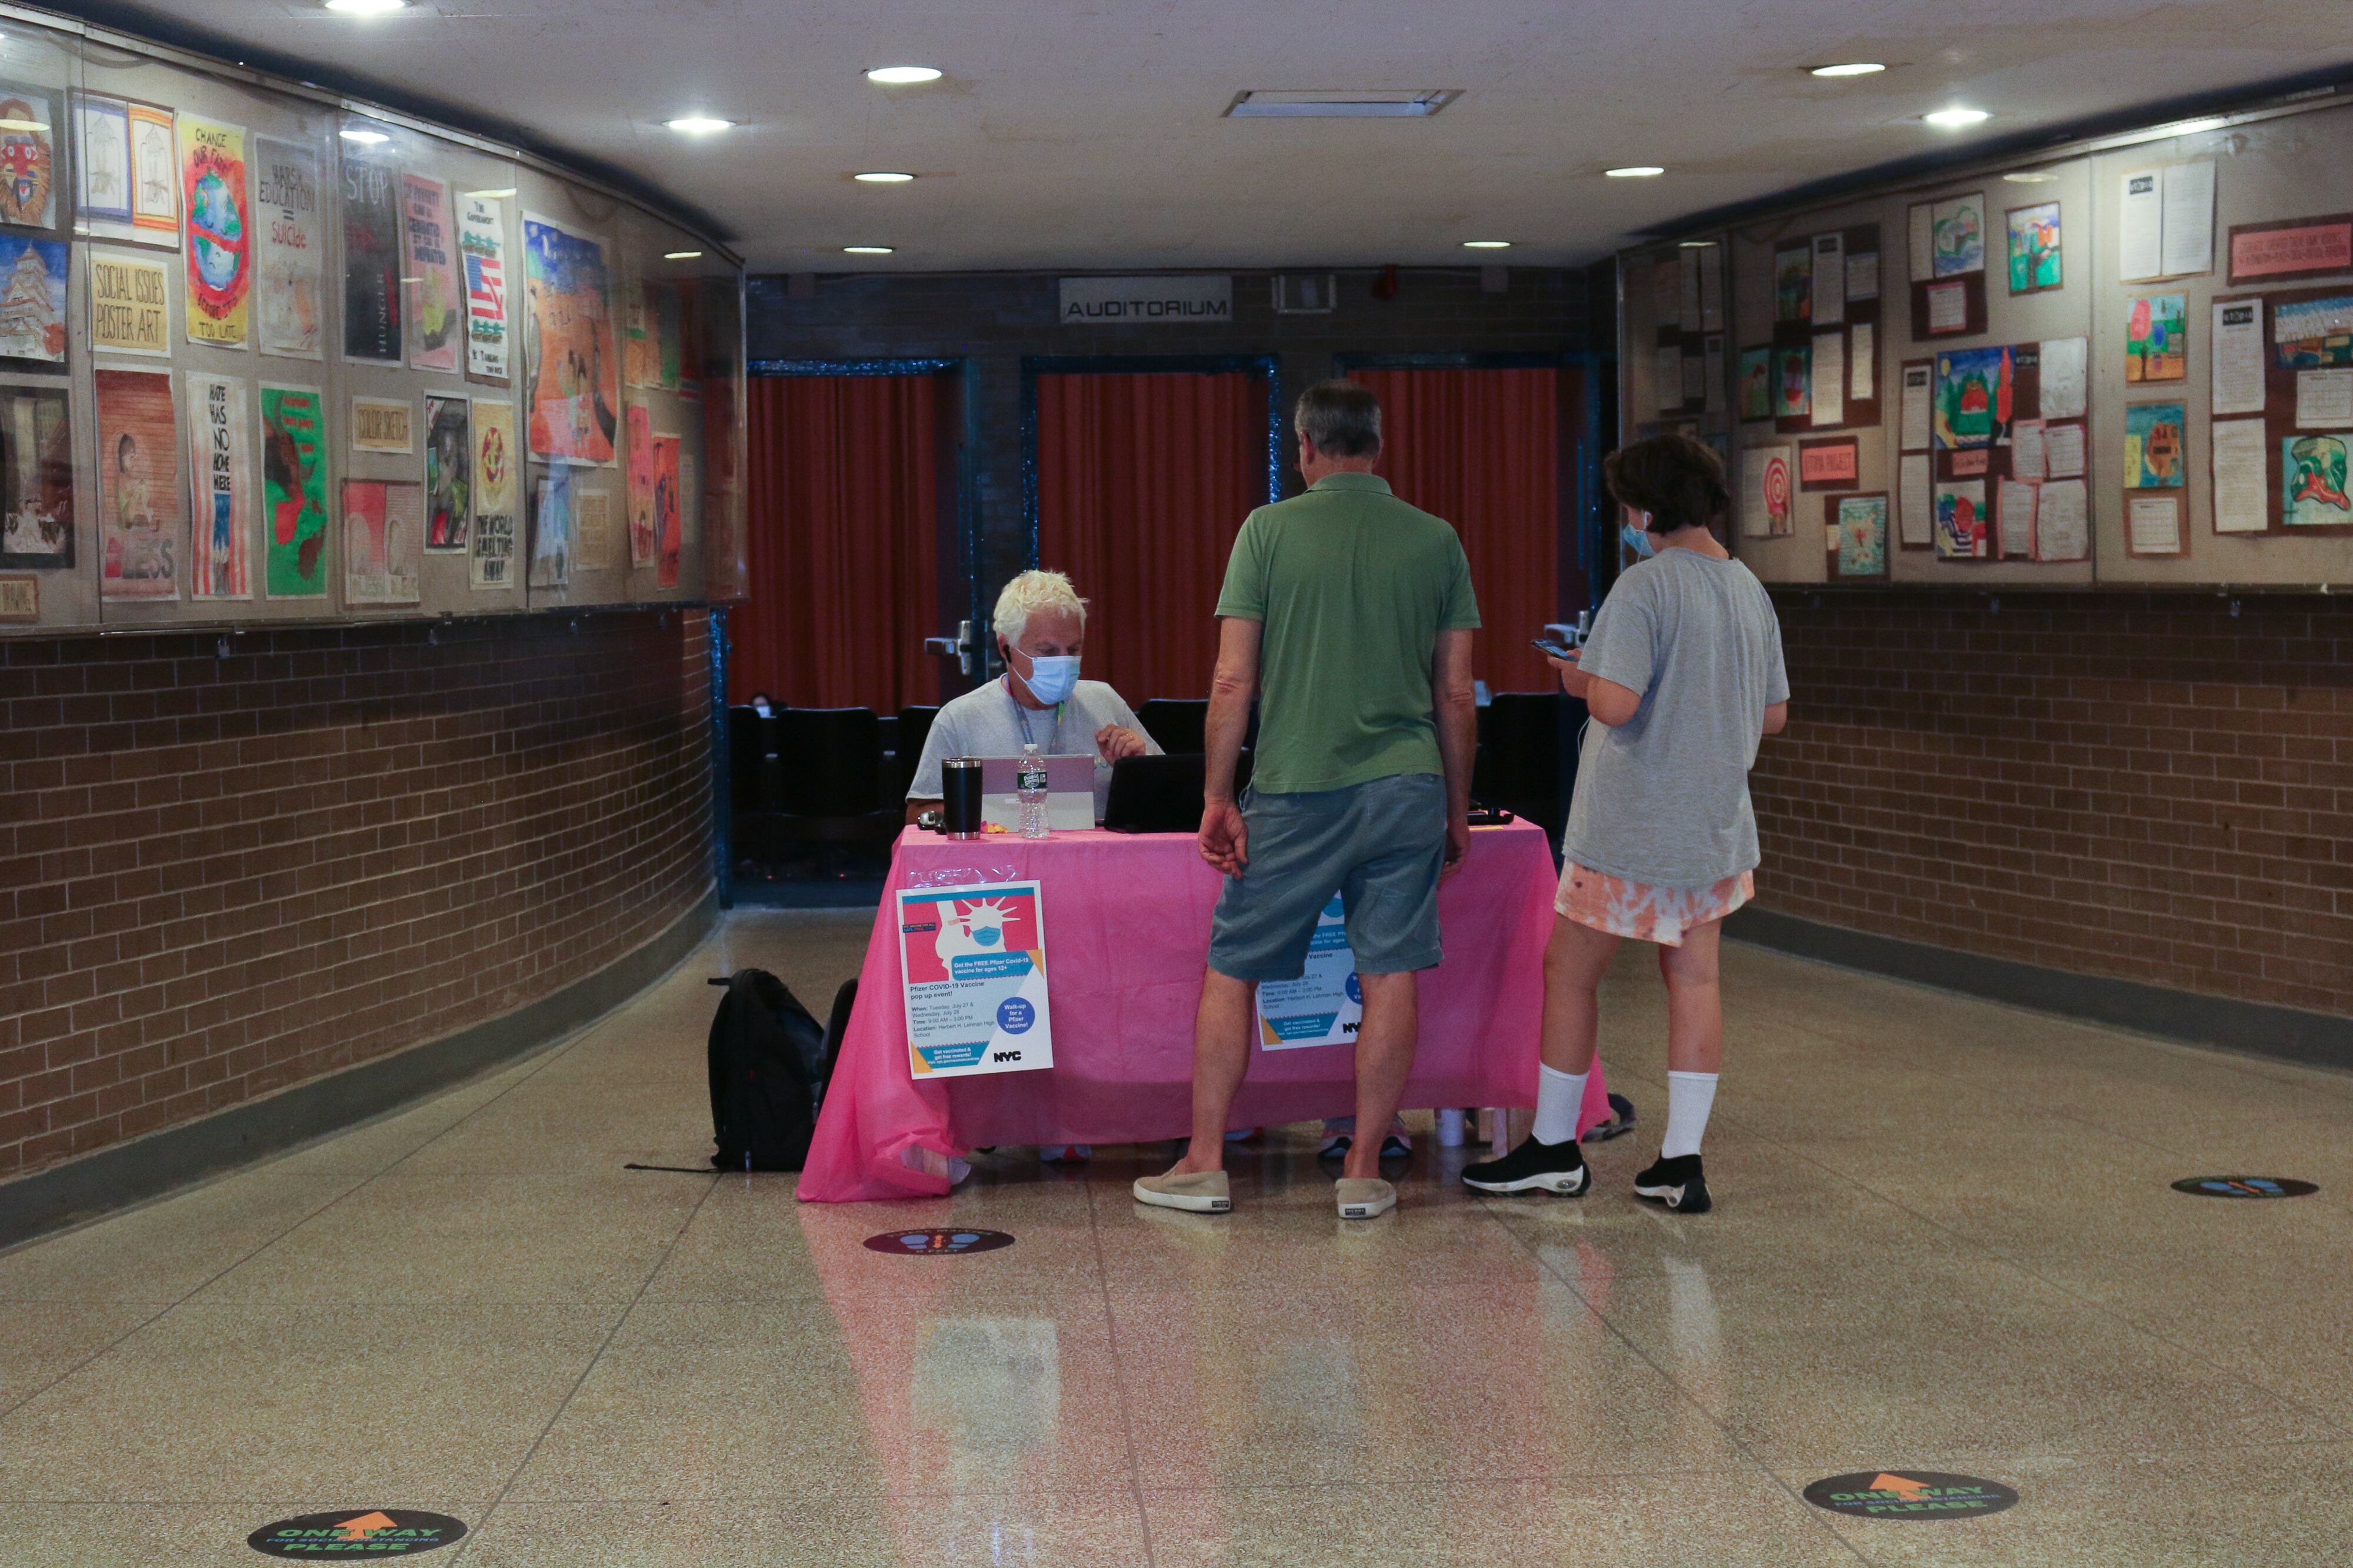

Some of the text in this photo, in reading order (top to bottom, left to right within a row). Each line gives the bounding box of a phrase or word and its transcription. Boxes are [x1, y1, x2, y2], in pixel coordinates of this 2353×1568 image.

[196, 128, 226, 147] CHANGE
[345, 165, 389, 207] STOP
[260, 181, 315, 212] EDUCATION
[96, 264, 164, 305] SOCIAL ISSUES
[1066, 300, 1227, 317] AUDITORIUM
[96, 304, 160, 342] POSTER ART
[199, 322, 215, 338] TOO
[209, 384, 226, 402] HATE
[209, 404, 226, 425] HAS
[214, 427, 230, 451] NO
[214, 452, 229, 472] HOME
[214, 473, 231, 491] HERE
[994, 1051, 1021, 1062] NYC
[1830, 1486, 1982, 1500] ONE WAY
[1866, 1500, 1987, 1513] PLEASE
